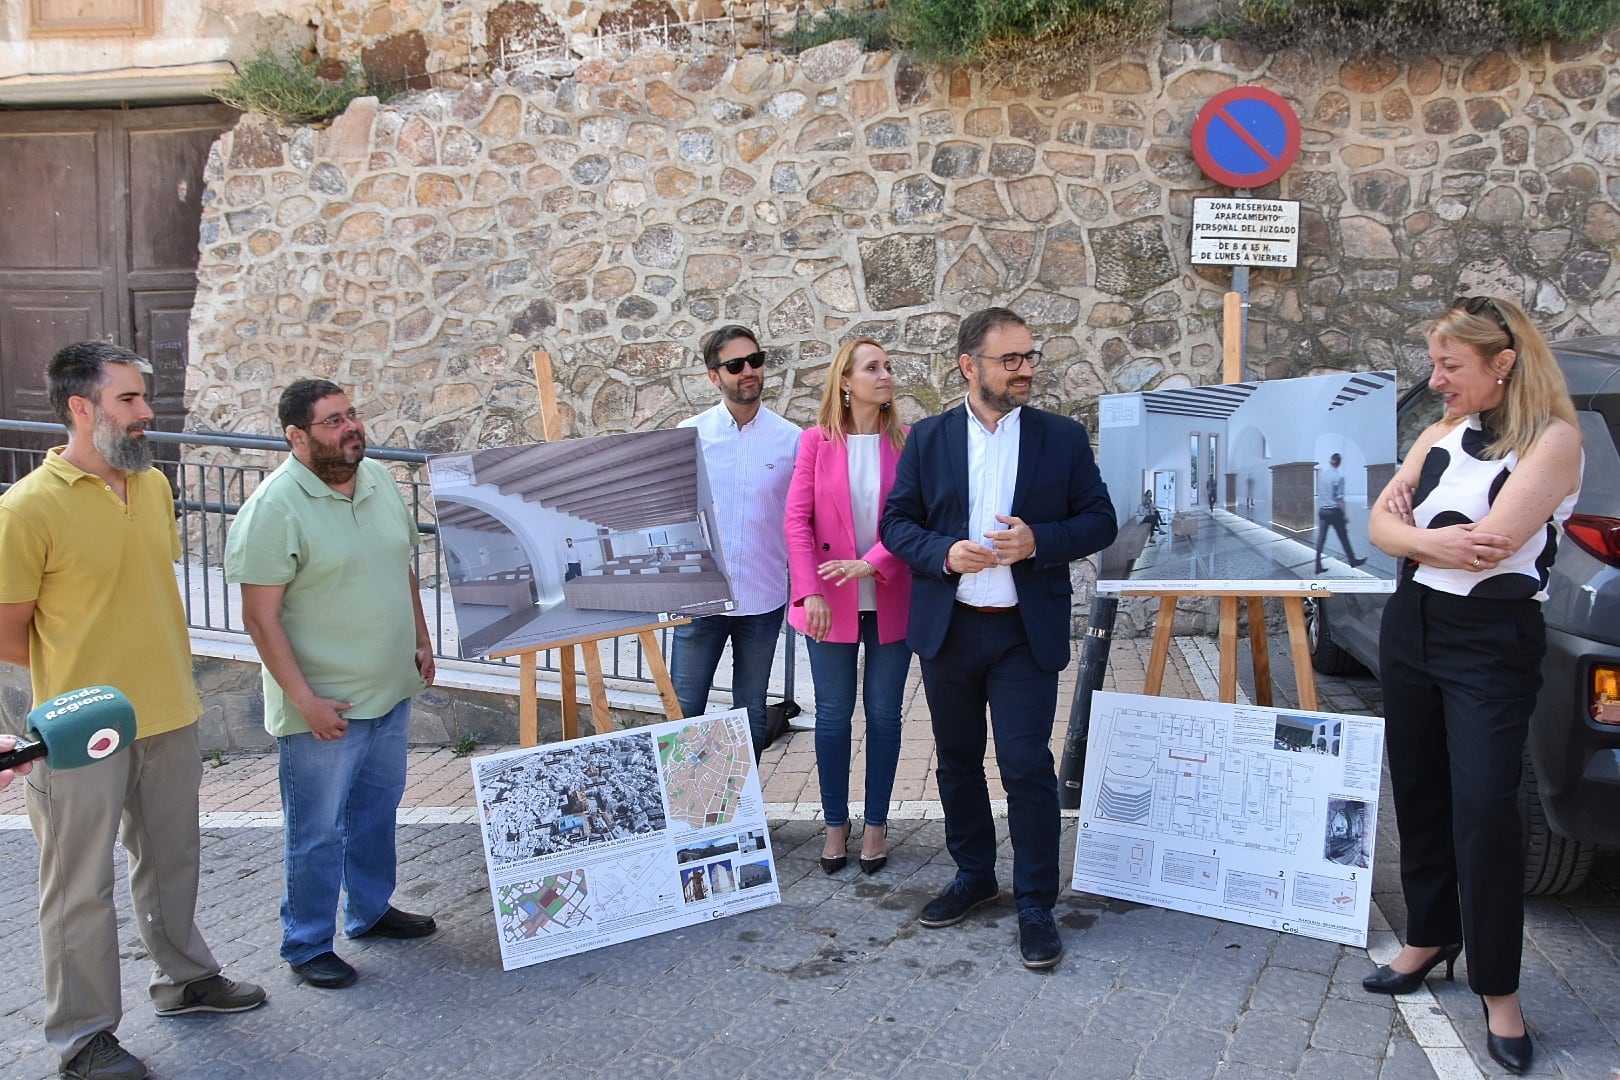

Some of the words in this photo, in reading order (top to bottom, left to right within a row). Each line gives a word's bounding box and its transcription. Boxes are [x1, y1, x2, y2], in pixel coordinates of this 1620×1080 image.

[1210, 202, 1231, 210] ZONA
[1235, 203, 1283, 212] RESERVADA
[1214, 212, 1279, 222] APARCAMIENTO
[1195, 223, 1238, 233] PERSONAL
[1241, 224, 1256, 232] DEL
[1259, 225, 1296, 234] JUZGADO
[1218, 242, 1229, 250] DE
[1232, 242, 1238, 250] 8
[1241, 243, 1247, 251] A
[1263, 244, 1271, 252] H.
[1201, 252, 1211, 260] DE
[1214, 252, 1241, 261] LUNES
[1244, 253, 1250, 261] A
[1252, 253, 1288, 262] VIERNES
[53, 687, 102, 707] Onda
[1278, 870, 1284, 878] 2
[1349, 872, 1356, 881] 3
